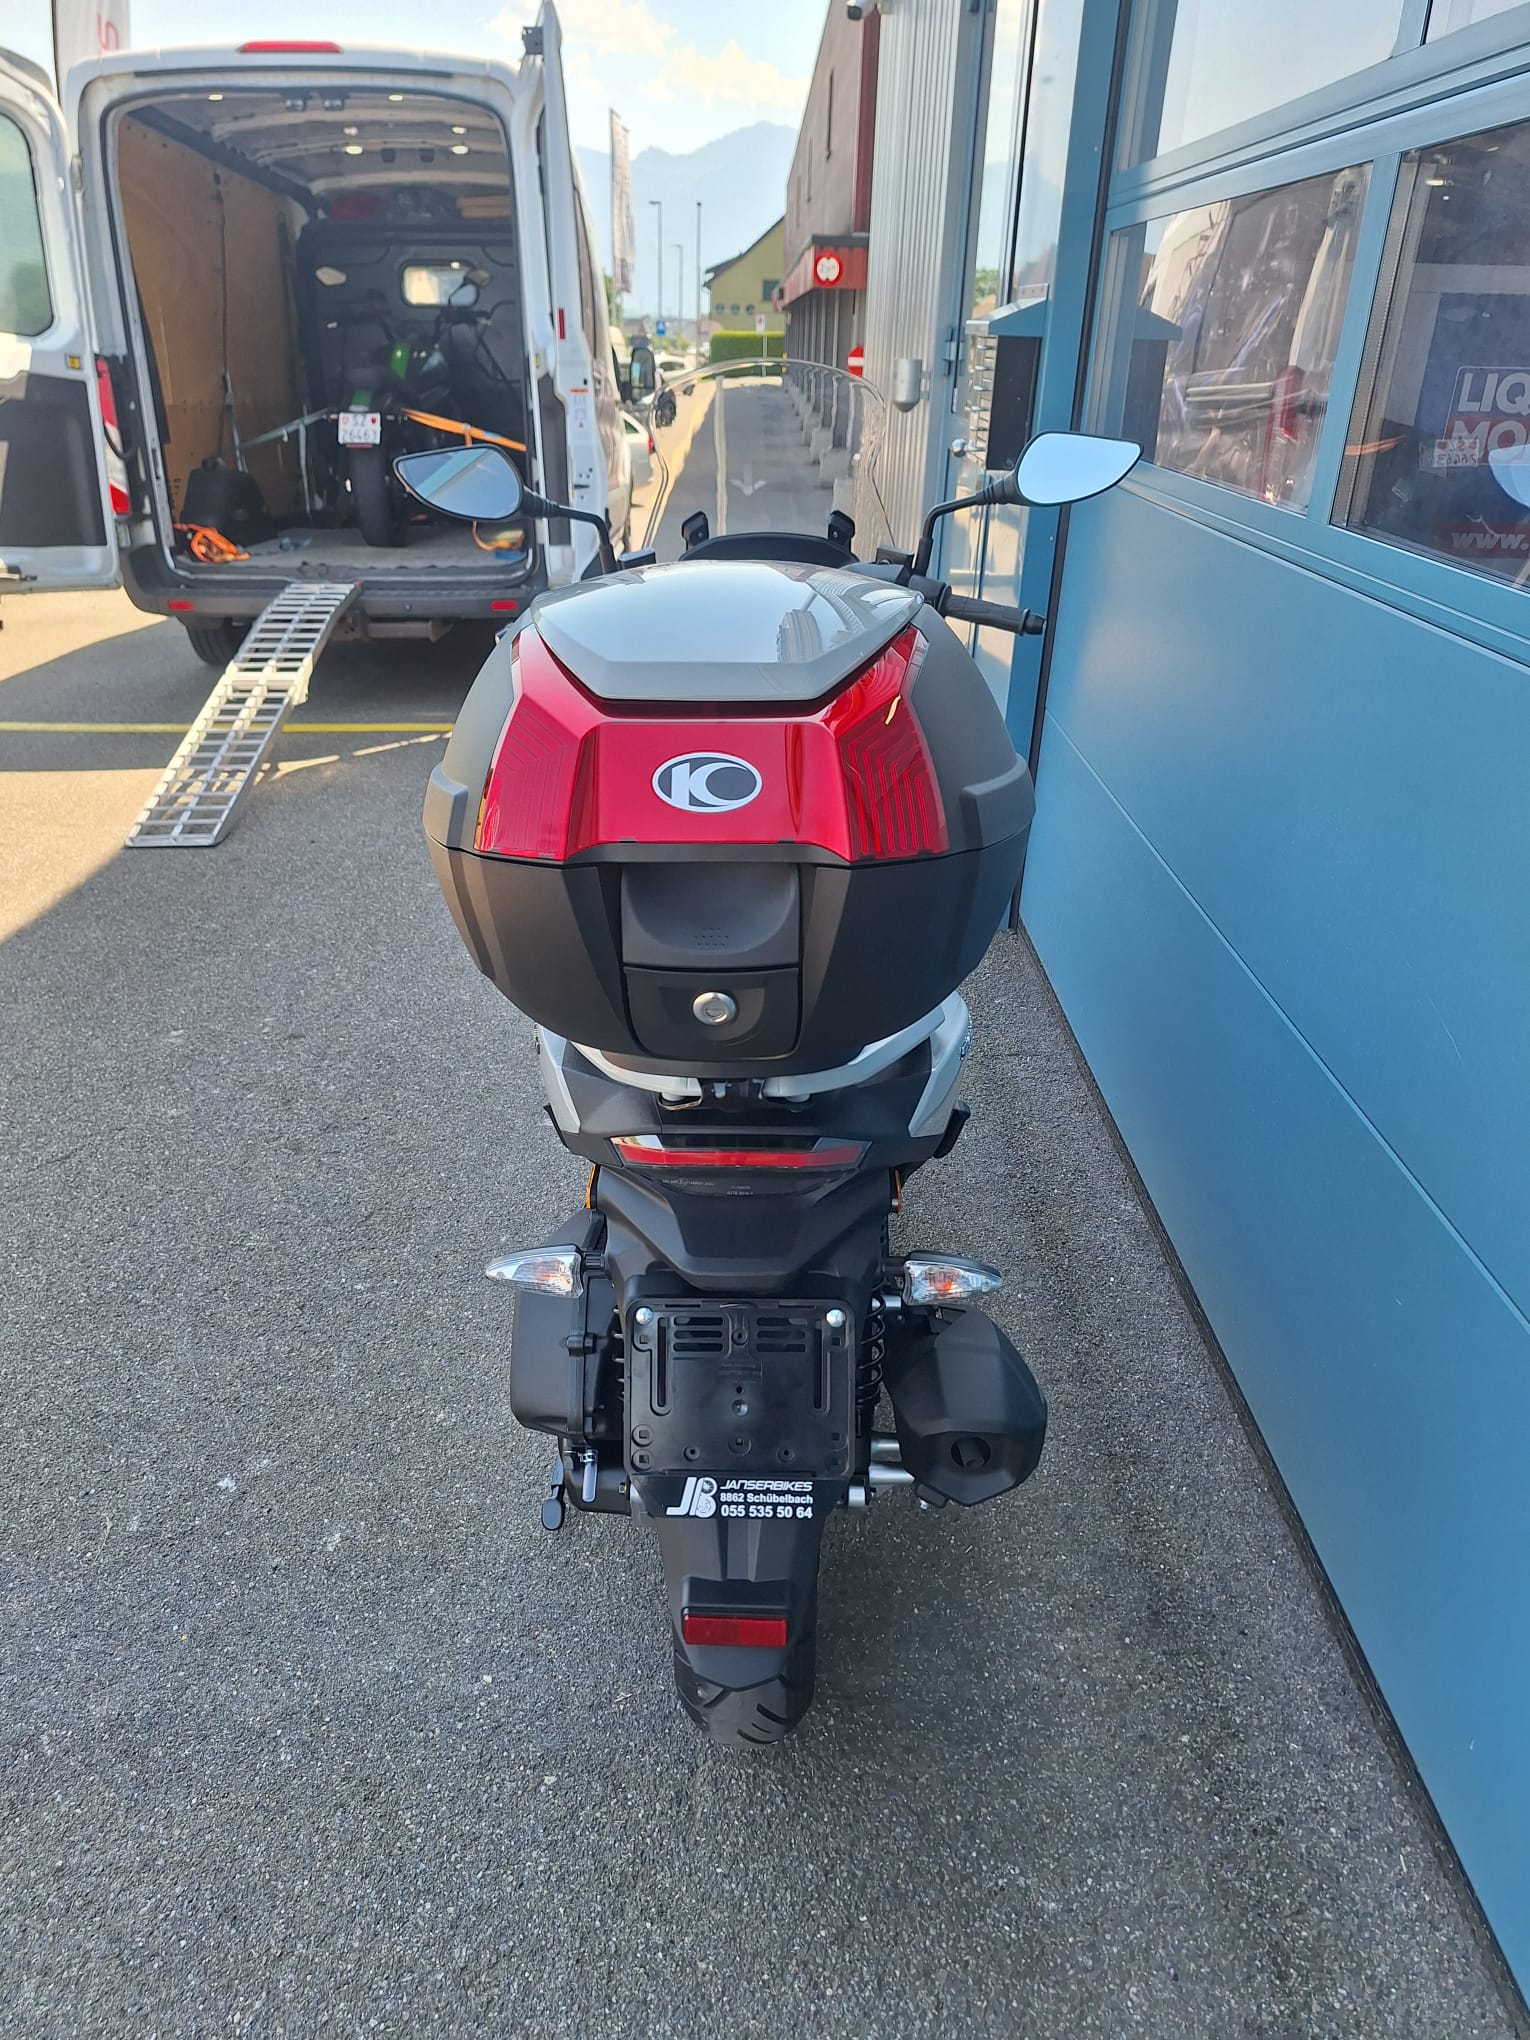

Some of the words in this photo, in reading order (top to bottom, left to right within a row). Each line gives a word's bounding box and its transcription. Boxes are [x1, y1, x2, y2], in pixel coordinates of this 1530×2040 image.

[1452, 420, 1530, 460] MO
[720, 1492, 745, 1502] 8862
[746, 1492, 814, 1504] Schübelbach
[720, 1504, 746, 1517] 055
[748, 1505, 774, 1518] 535
[776, 1505, 793, 1518] 50
[795, 1506, 814, 1519] 64
